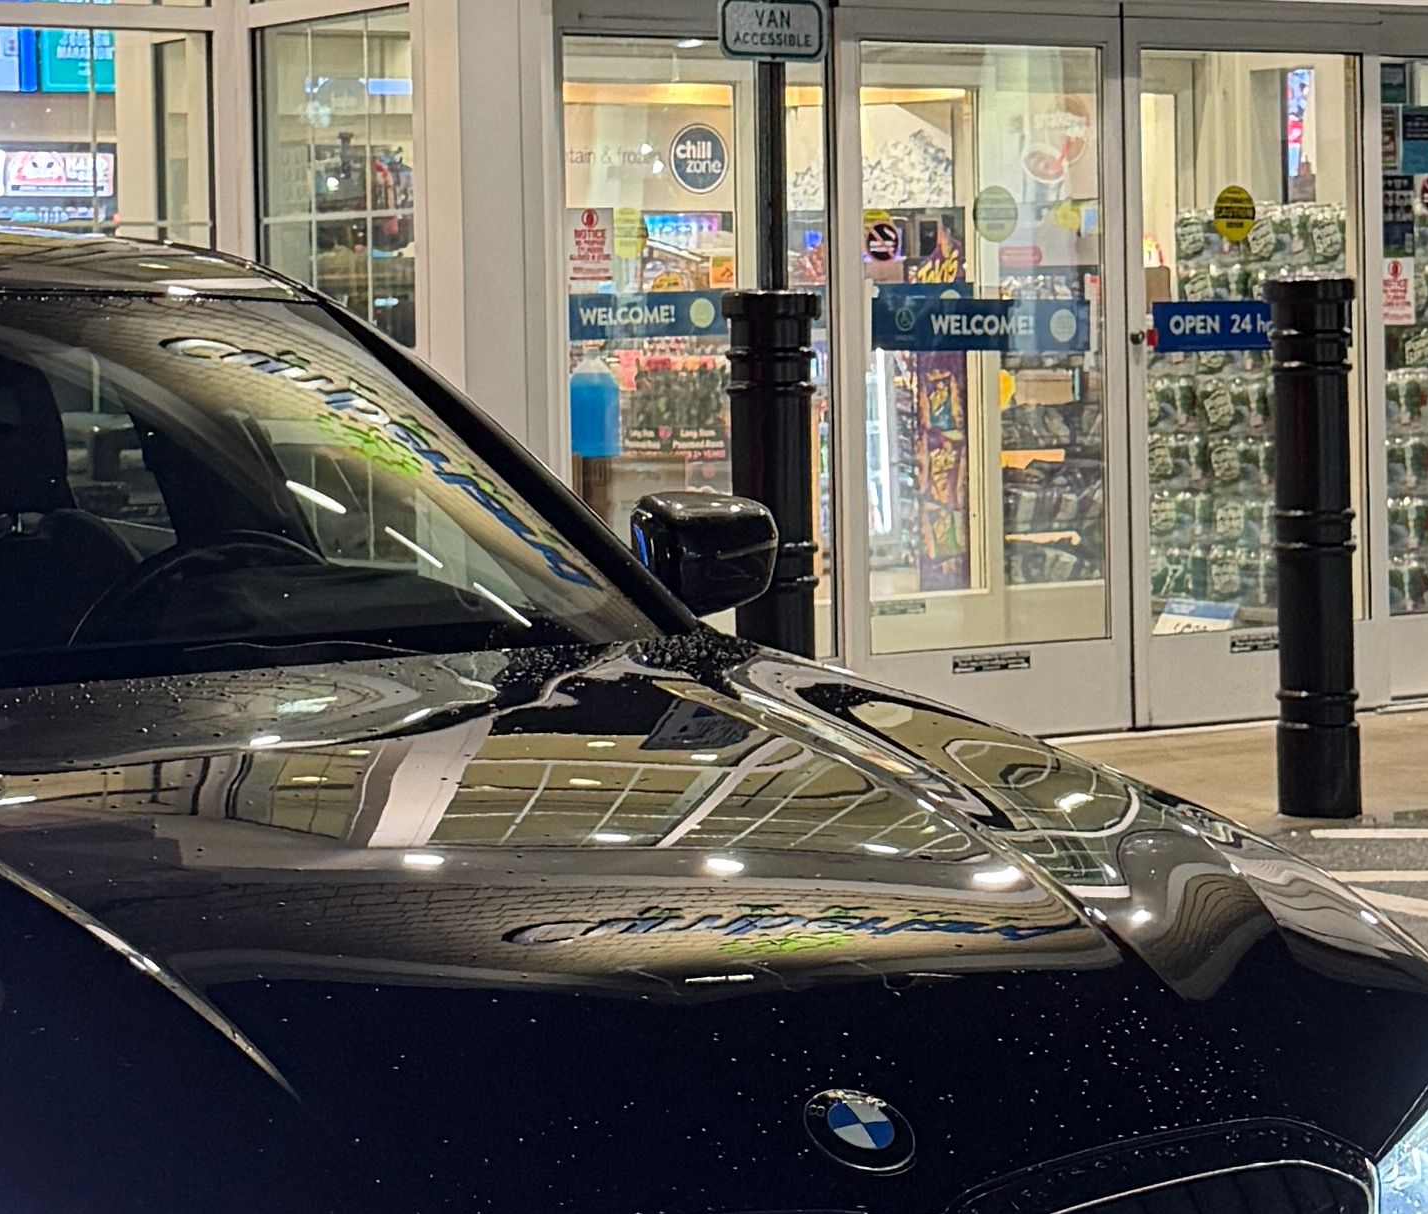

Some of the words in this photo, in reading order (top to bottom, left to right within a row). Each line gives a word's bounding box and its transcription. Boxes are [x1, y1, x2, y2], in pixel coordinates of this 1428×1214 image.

[755, 9, 791, 29] VAN
[733, 31, 812, 48] ACCESSIBLE
[675, 140, 712, 161] chill
[685, 157, 723, 174] zone
[579, 304, 676, 327] WELCOME!
[930, 312, 1035, 336] WELCOME!
[1169, 314, 1221, 336] OPEN
[1229, 312, 1253, 334] 24
